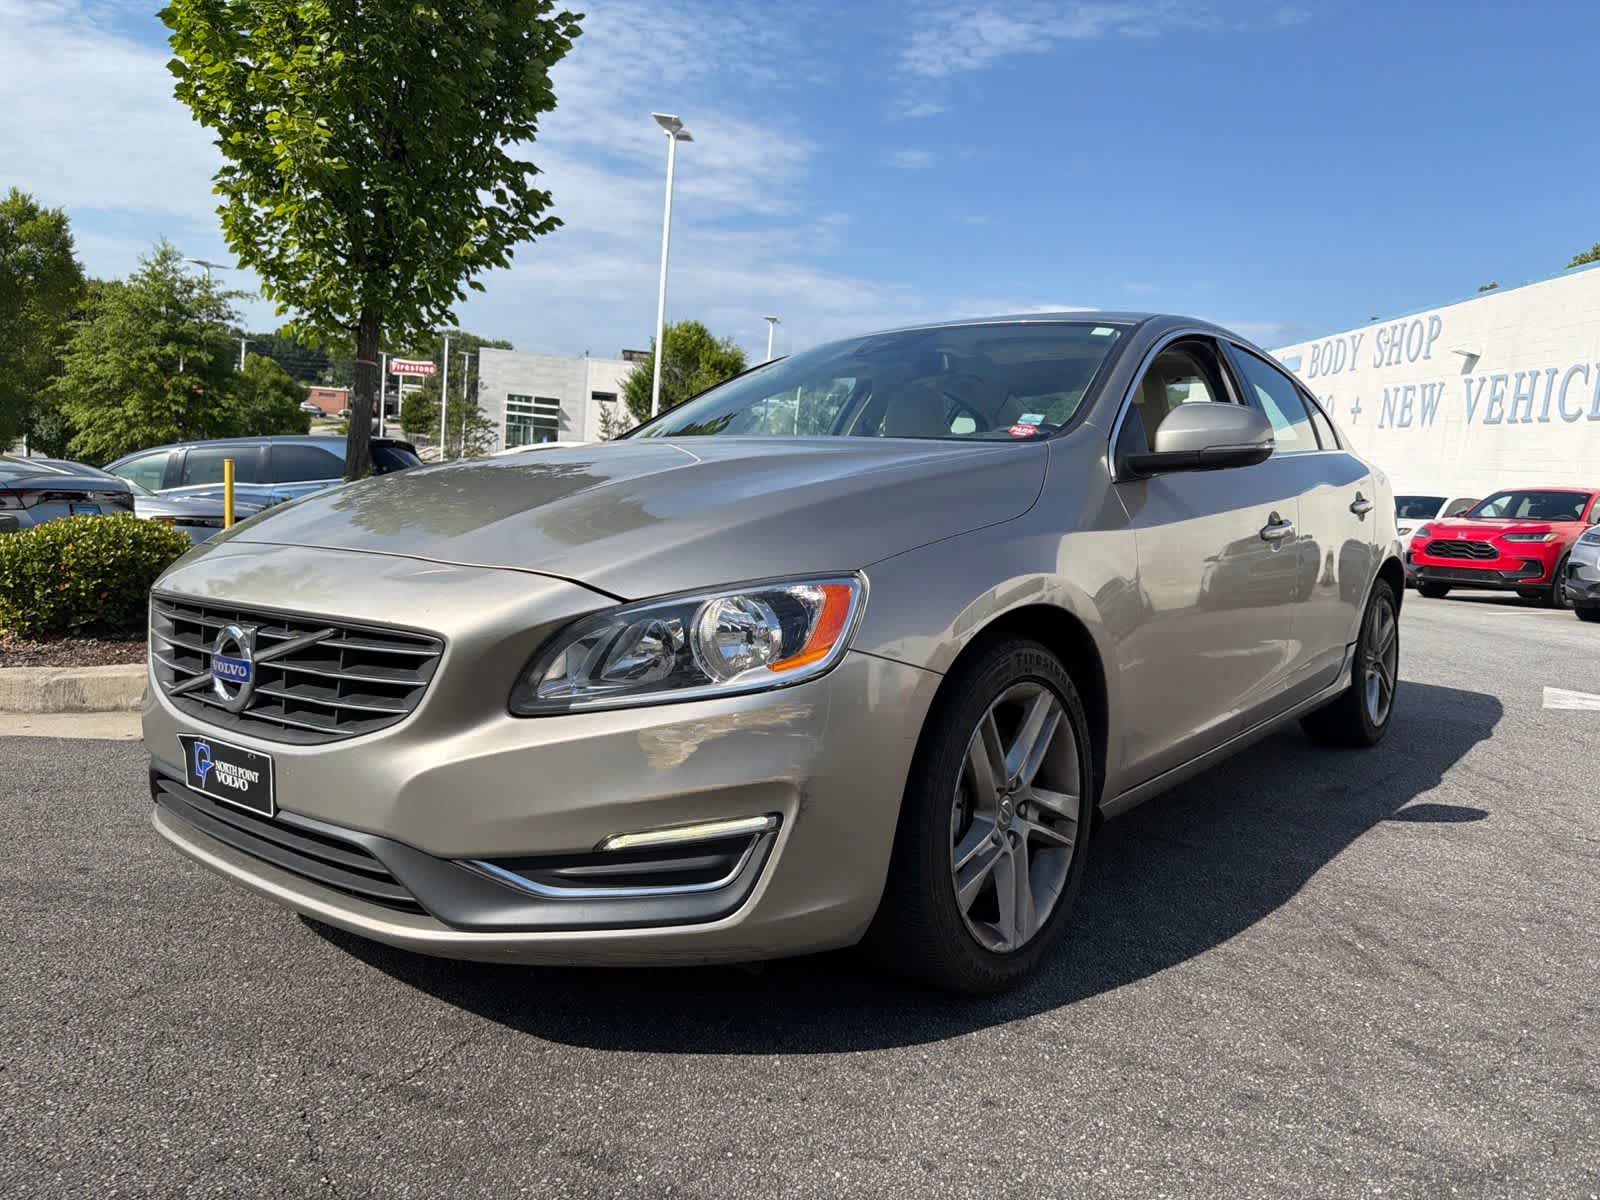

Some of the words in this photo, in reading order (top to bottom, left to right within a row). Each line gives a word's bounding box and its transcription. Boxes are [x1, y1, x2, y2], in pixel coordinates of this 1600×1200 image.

[1308, 334, 1364, 378] BODY
[1373, 315, 1442, 368] SHOP
[1378, 382, 1445, 429] NEW
[212, 660, 247, 677] VOLVO
[215, 760, 237, 777] NORTH
[238, 768, 259, 783] POINT
[215, 771, 248, 791] VOLVO
